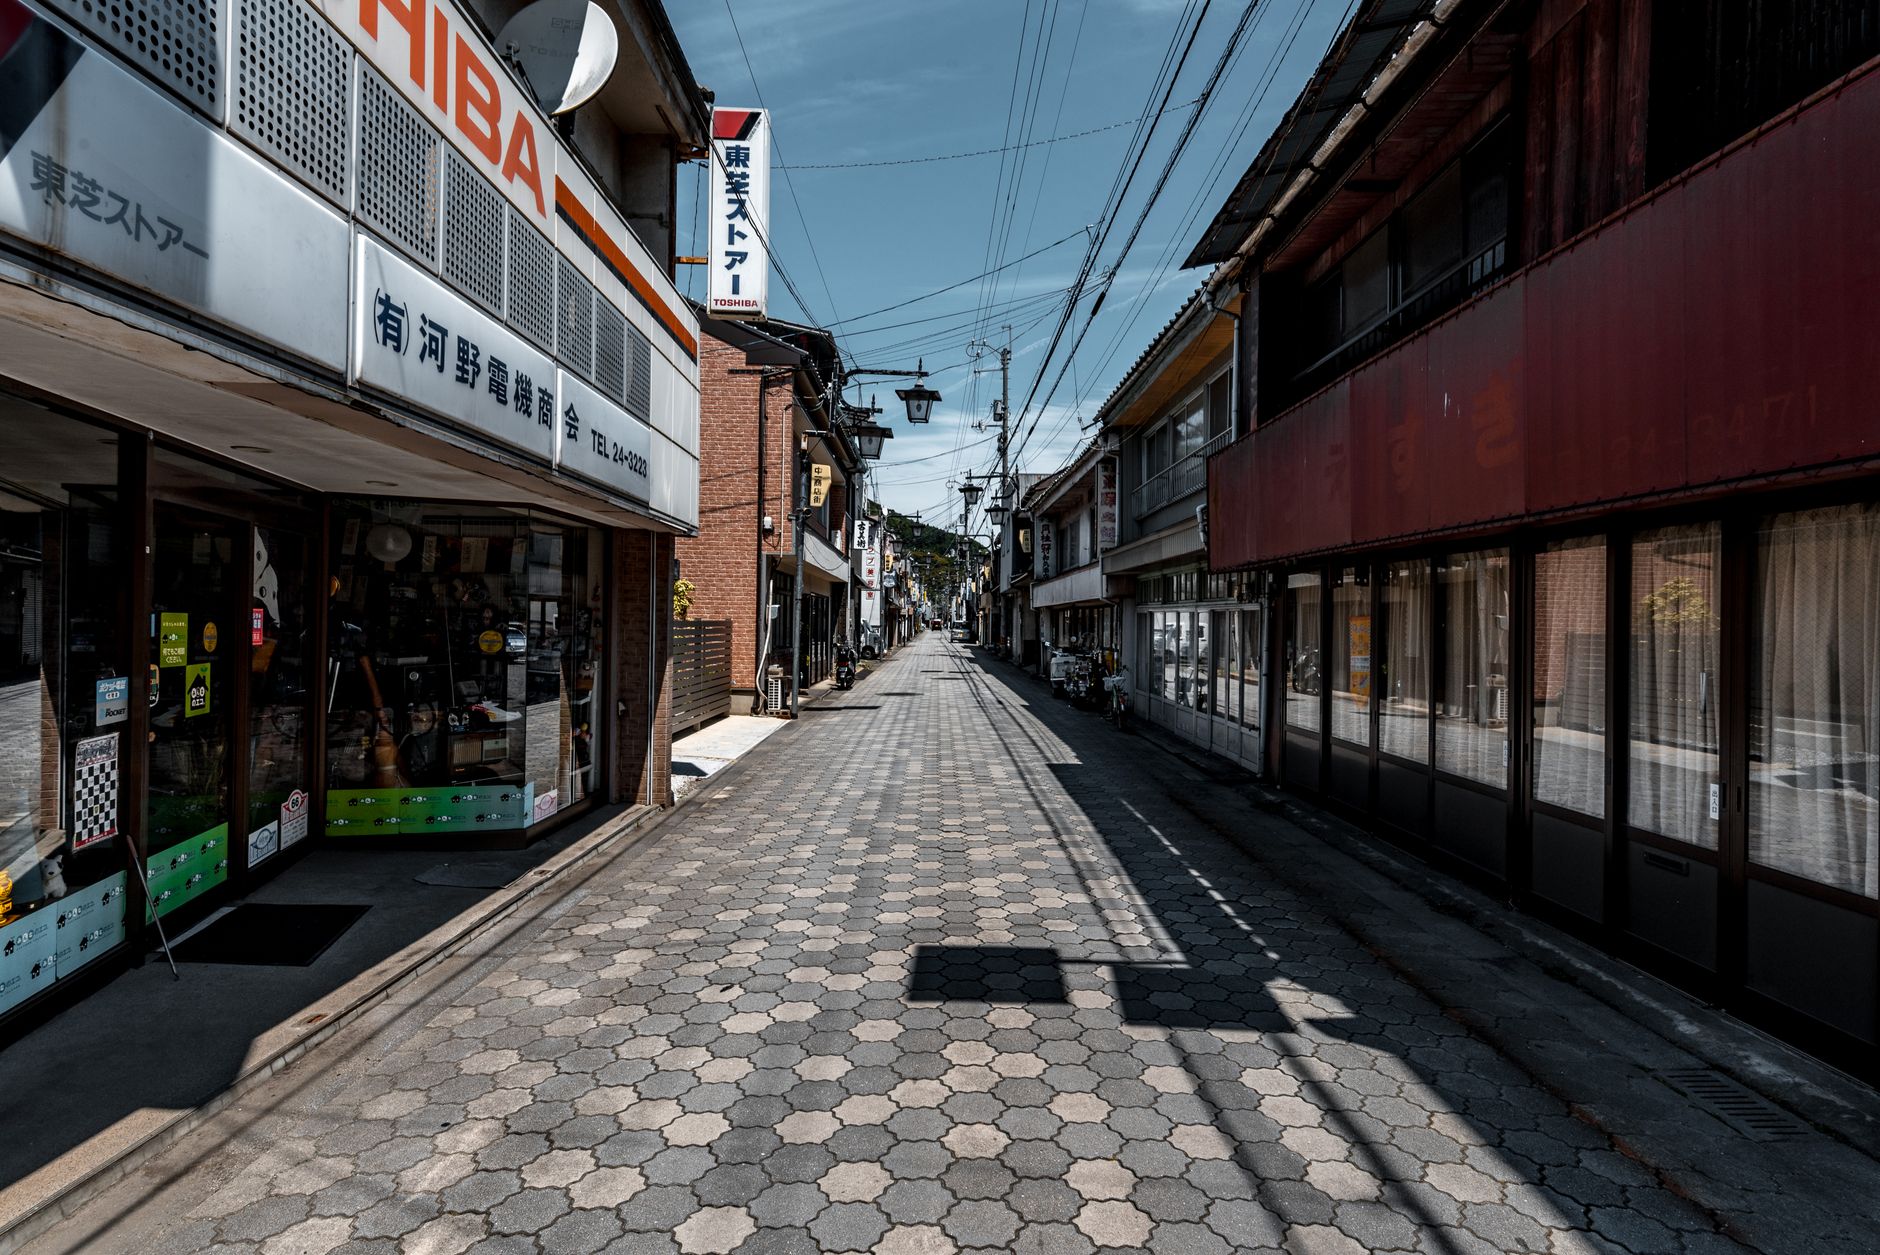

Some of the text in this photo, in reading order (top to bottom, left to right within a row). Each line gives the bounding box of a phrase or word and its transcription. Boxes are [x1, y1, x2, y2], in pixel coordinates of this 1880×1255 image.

[30, 149, 210, 260] 東芝ストアー
[725, 145, 750, 295] 東芝ストアー
[714, 298, 758, 308] TOSHIBA
[591, 428, 610, 460] TEL
[612, 440, 648, 479] 24-3223
[857, 522, 867, 548] 古美術
